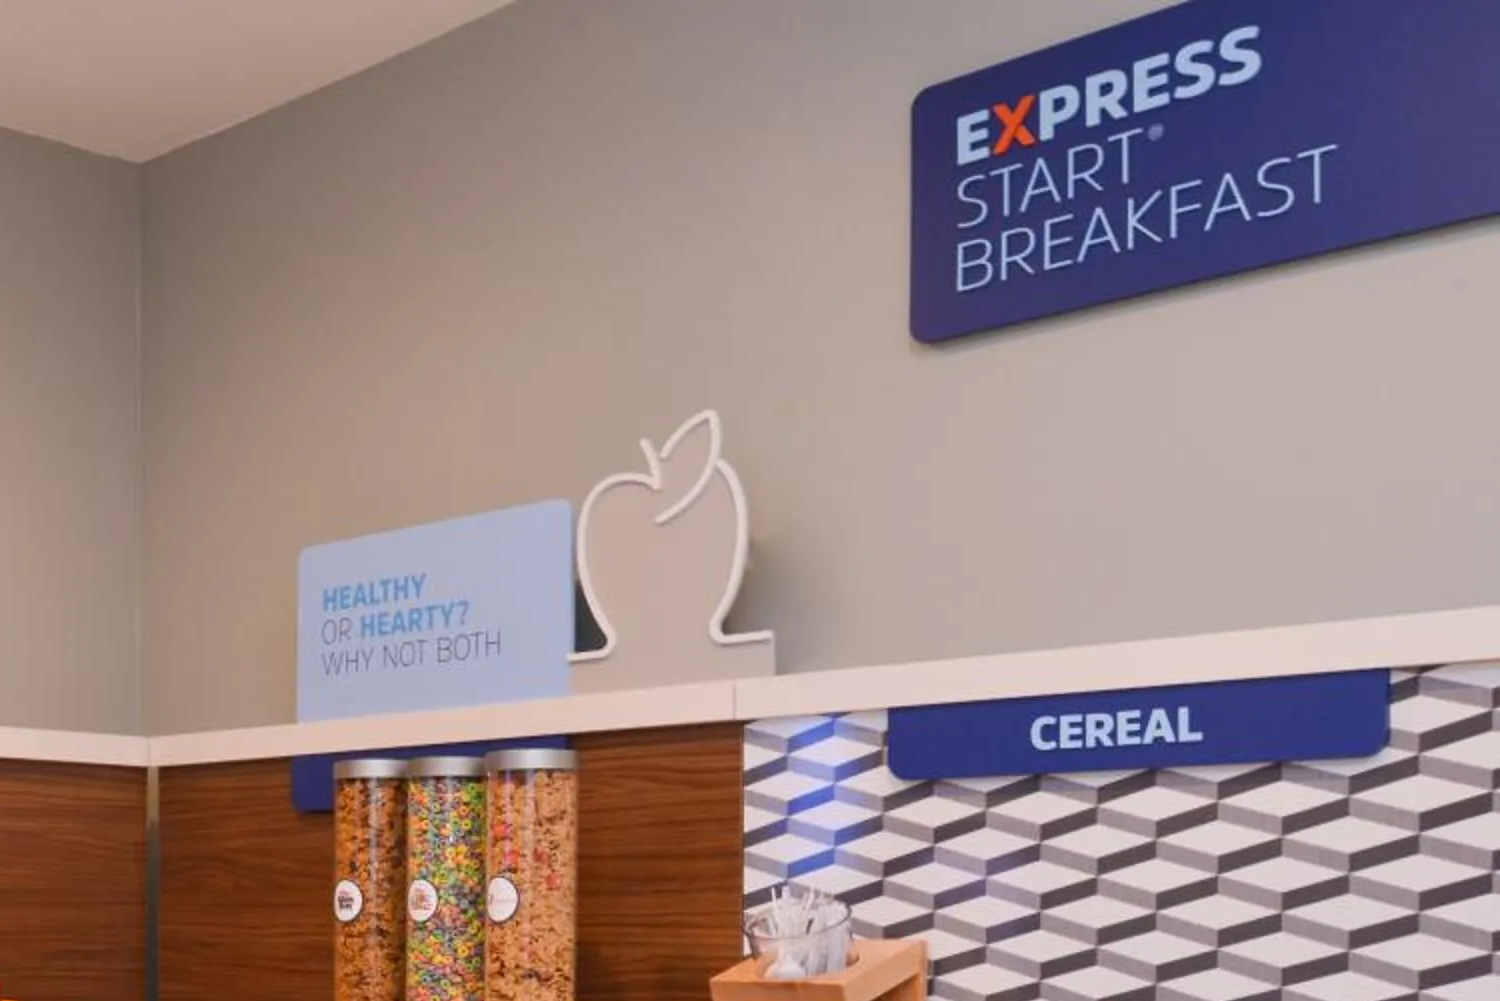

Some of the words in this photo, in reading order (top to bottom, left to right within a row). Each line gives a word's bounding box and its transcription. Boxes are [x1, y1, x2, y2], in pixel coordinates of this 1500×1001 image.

[956, 25, 1262, 166] EXPRESS
[956, 143, 1339, 292] BREAKFAST
[322, 573, 428, 612] HEALTHY
[320, 617, 352, 646] OR
[359, 601, 470, 638] HEARTY?
[320, 646, 375, 676] WHY
[382, 639, 429, 669] NOT
[436, 629, 502, 664] BOTH
[1029, 706, 1204, 751] CEREAL
